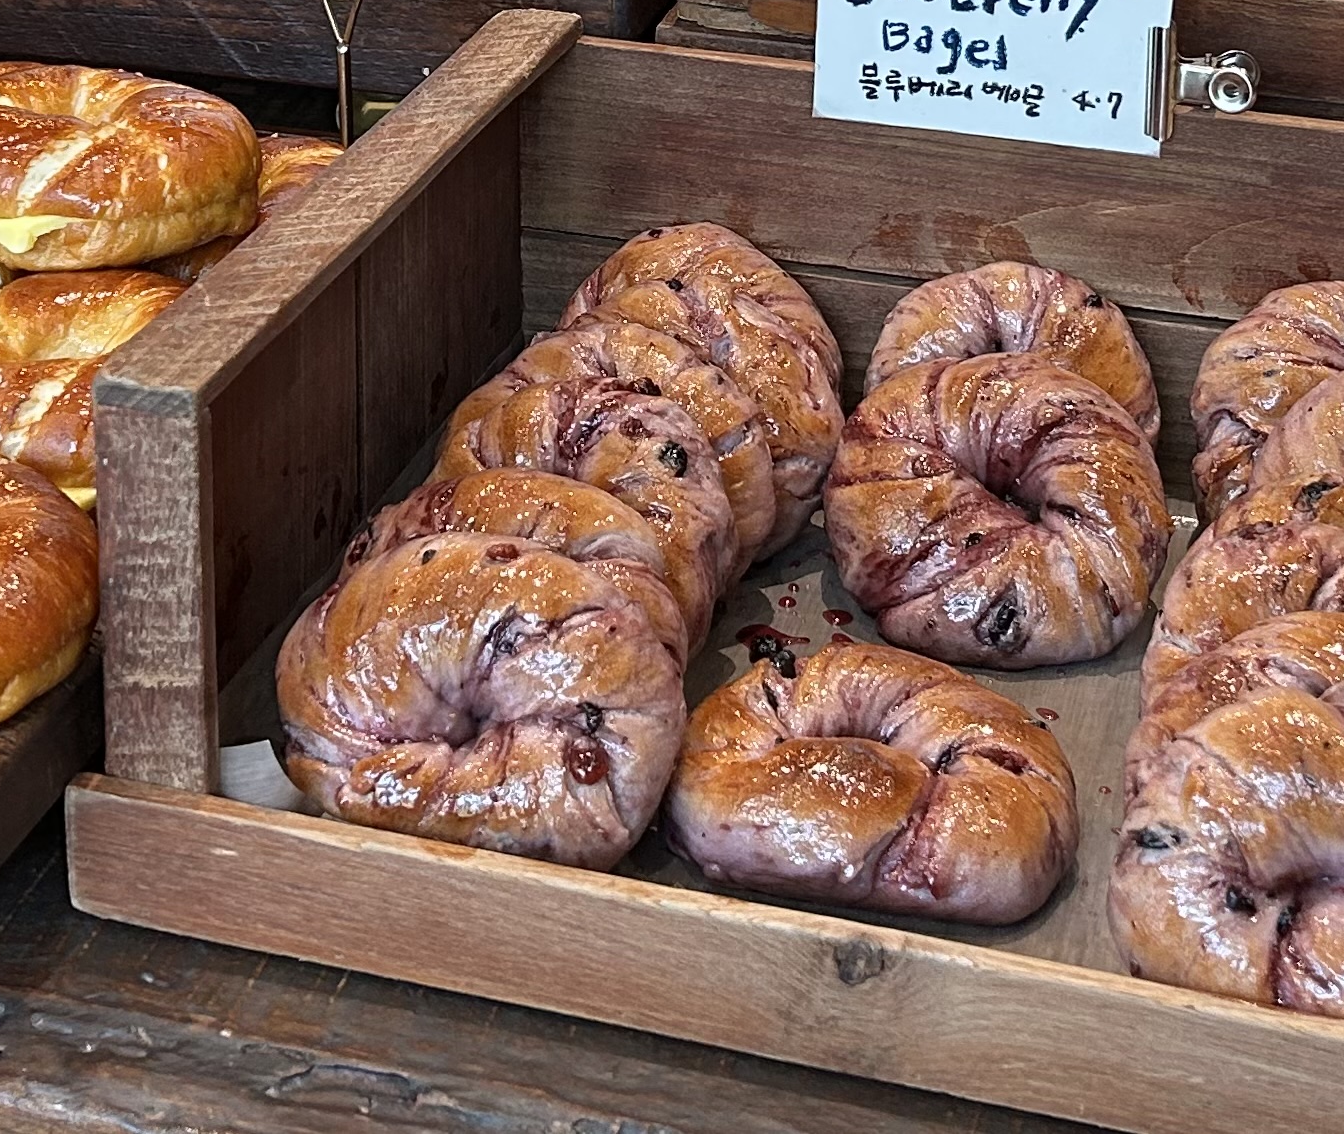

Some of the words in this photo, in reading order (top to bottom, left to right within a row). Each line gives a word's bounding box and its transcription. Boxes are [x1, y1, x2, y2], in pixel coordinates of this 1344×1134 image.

[882, 18, 1008, 75] Bagel
[858, 63, 973, 102] 블루베리
[981, 81, 1045, 117] 베이글
[1072, 90, 1123, 119] 4.7
